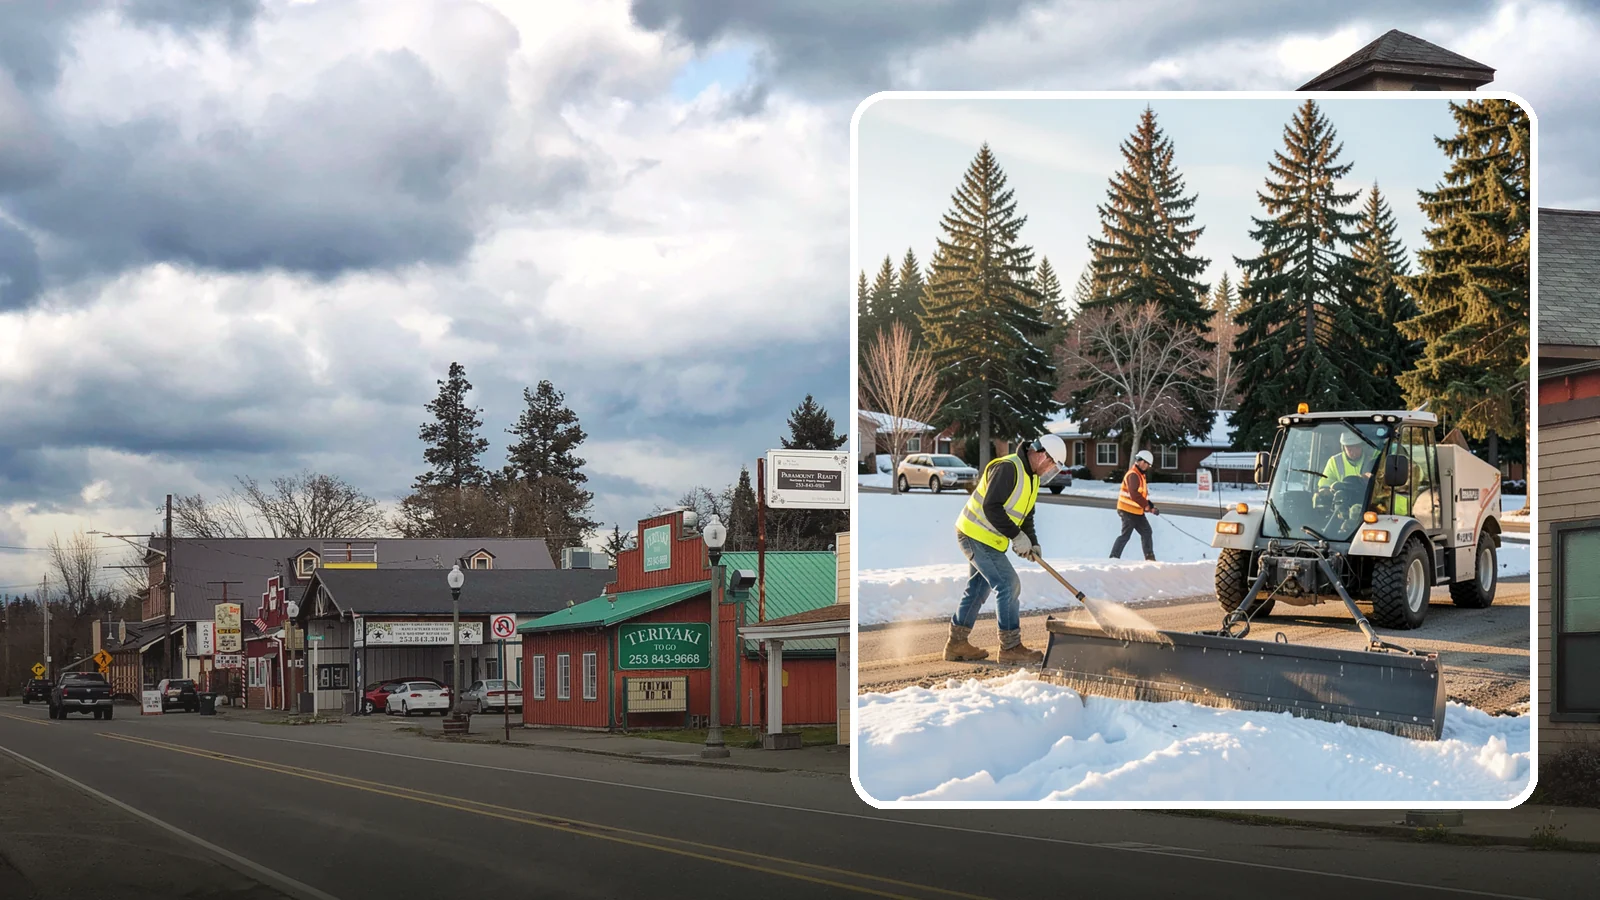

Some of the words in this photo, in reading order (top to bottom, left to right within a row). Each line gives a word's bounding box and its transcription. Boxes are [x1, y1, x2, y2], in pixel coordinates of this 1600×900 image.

[625, 627, 702, 646] TERIYAKI
[629, 654, 648, 664] 253
[651, 654, 700, 664] 843-9668
[639, 681, 672, 691] TERIYAKI
